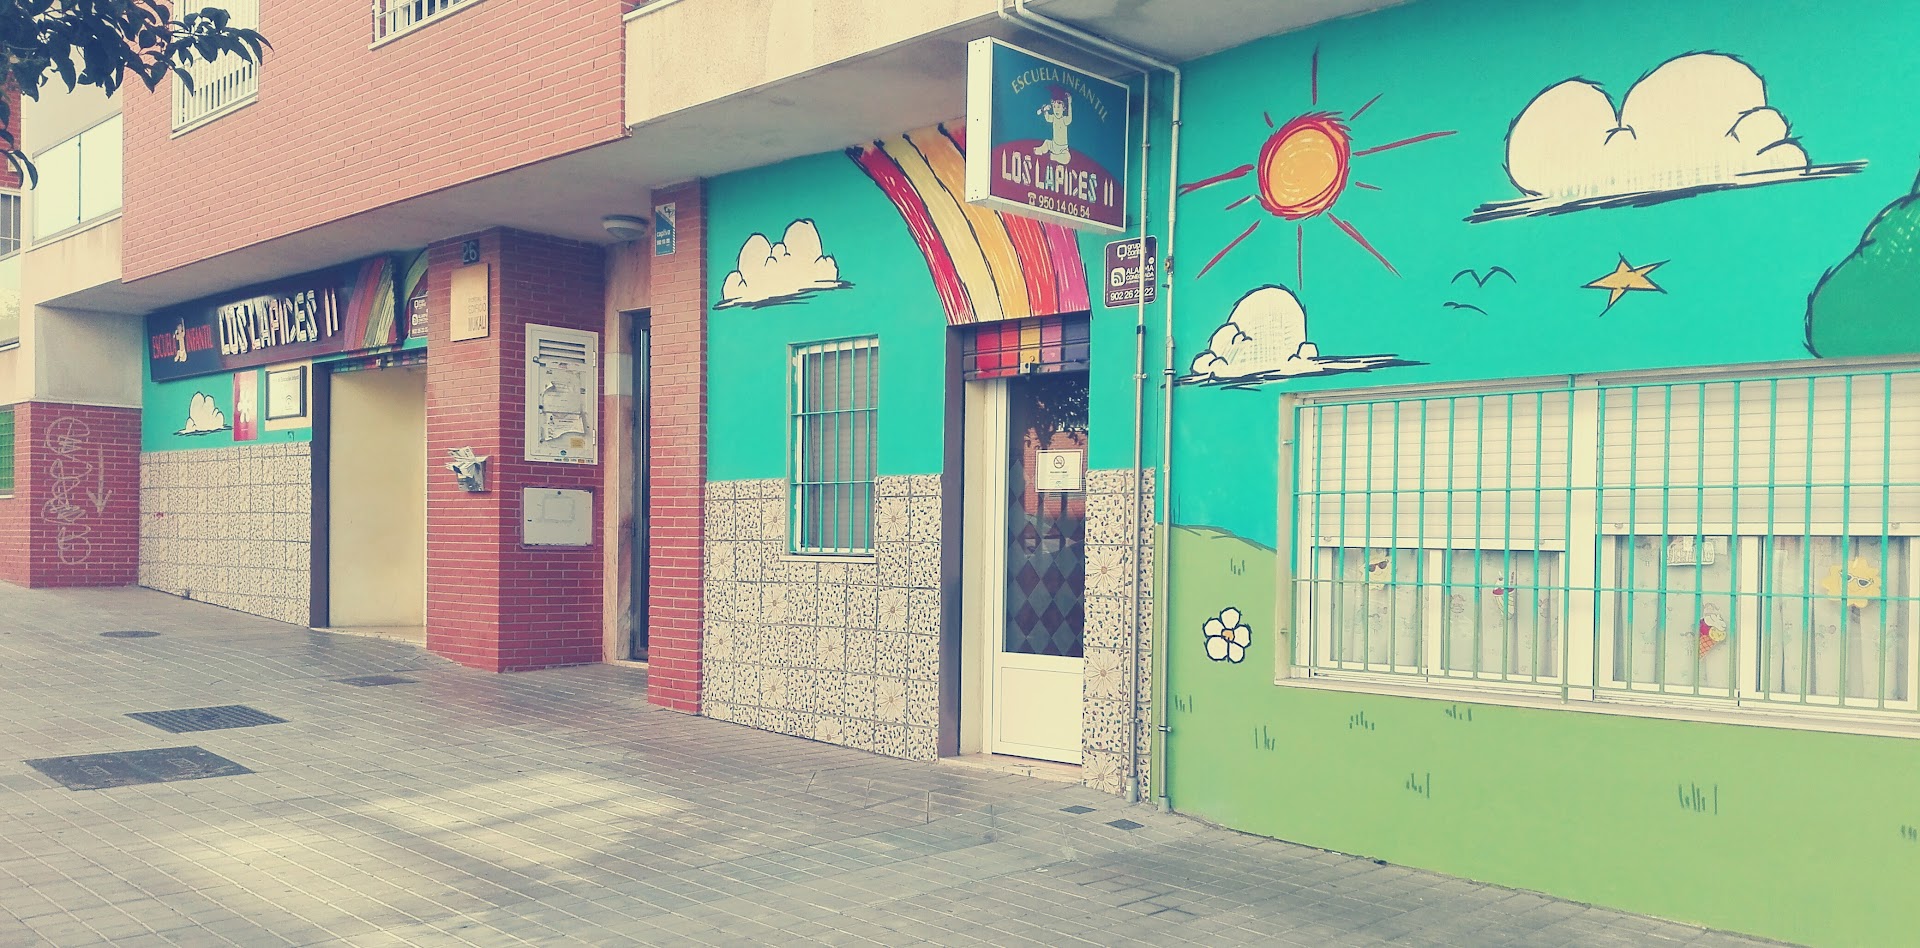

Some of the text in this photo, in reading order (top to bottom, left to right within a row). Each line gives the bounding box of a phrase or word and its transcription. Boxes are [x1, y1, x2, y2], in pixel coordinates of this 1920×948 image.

[1011, 67, 1108, 122] ESCUELA INFANTIL
[1001, 148, 1032, 187] LOS
[1035, 157, 1098, 204] LAPICES
[1038, 195, 1091, 219] 950 14 06 54
[463, 241, 478, 263] 26
[1110, 291, 1124, 301] 902
[1124, 289, 1134, 300] 26
[1144, 287, 1154, 297] 22
[219, 305, 248, 356] LOS
[248, 290, 317, 350] LAPICES
